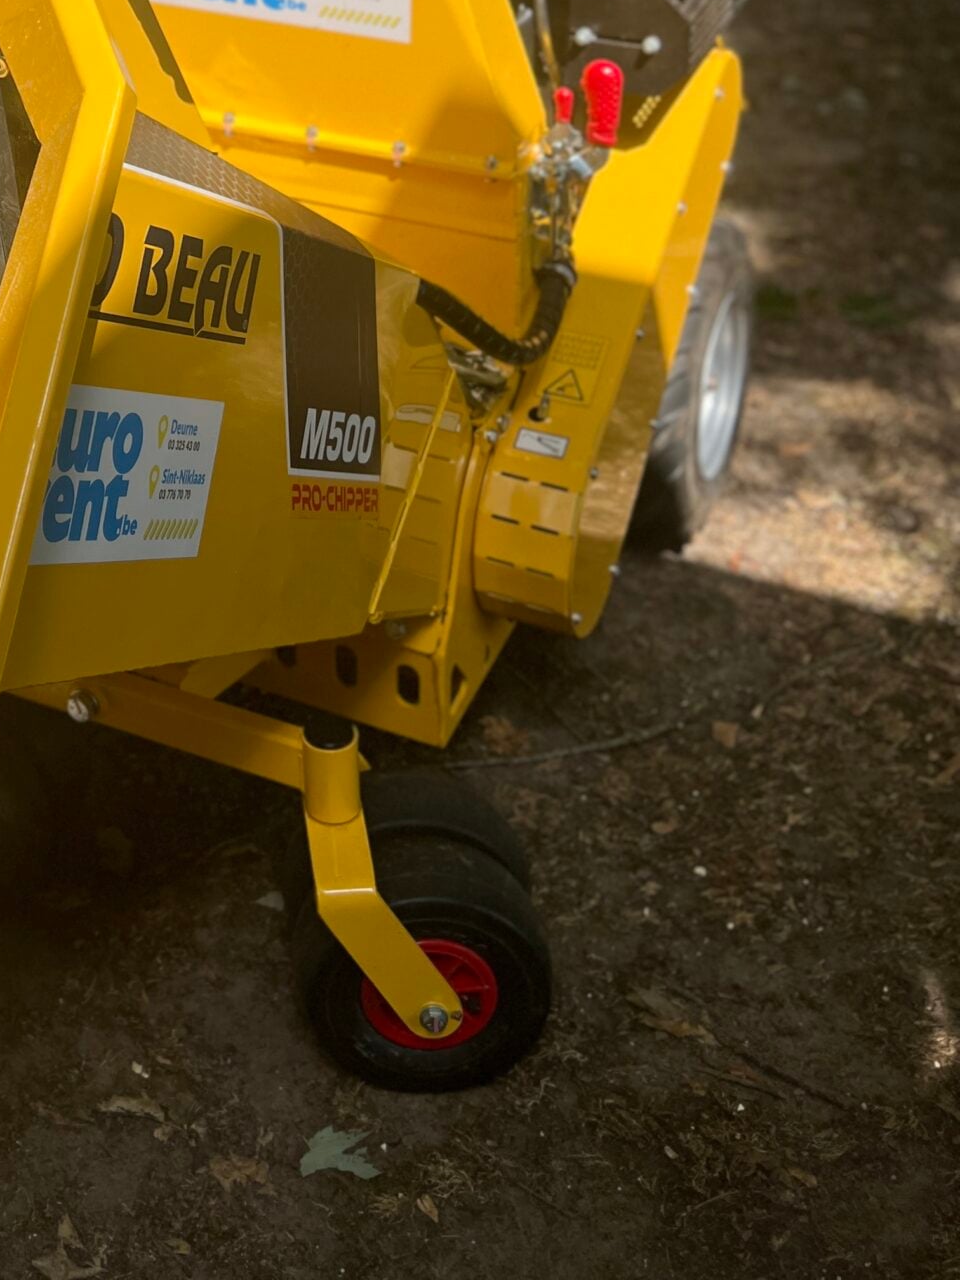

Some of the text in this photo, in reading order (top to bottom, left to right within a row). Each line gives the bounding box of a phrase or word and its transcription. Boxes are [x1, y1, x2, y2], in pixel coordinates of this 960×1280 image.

[132, 225, 261, 336] BEAU
[52, 407, 144, 475] uro
[171, 419, 198, 436] Deurne
[300, 407, 376, 464] M500
[161, 468, 206, 485] Sint-Niklaas
[292, 484, 379, 513] PRO-CHIPPER
